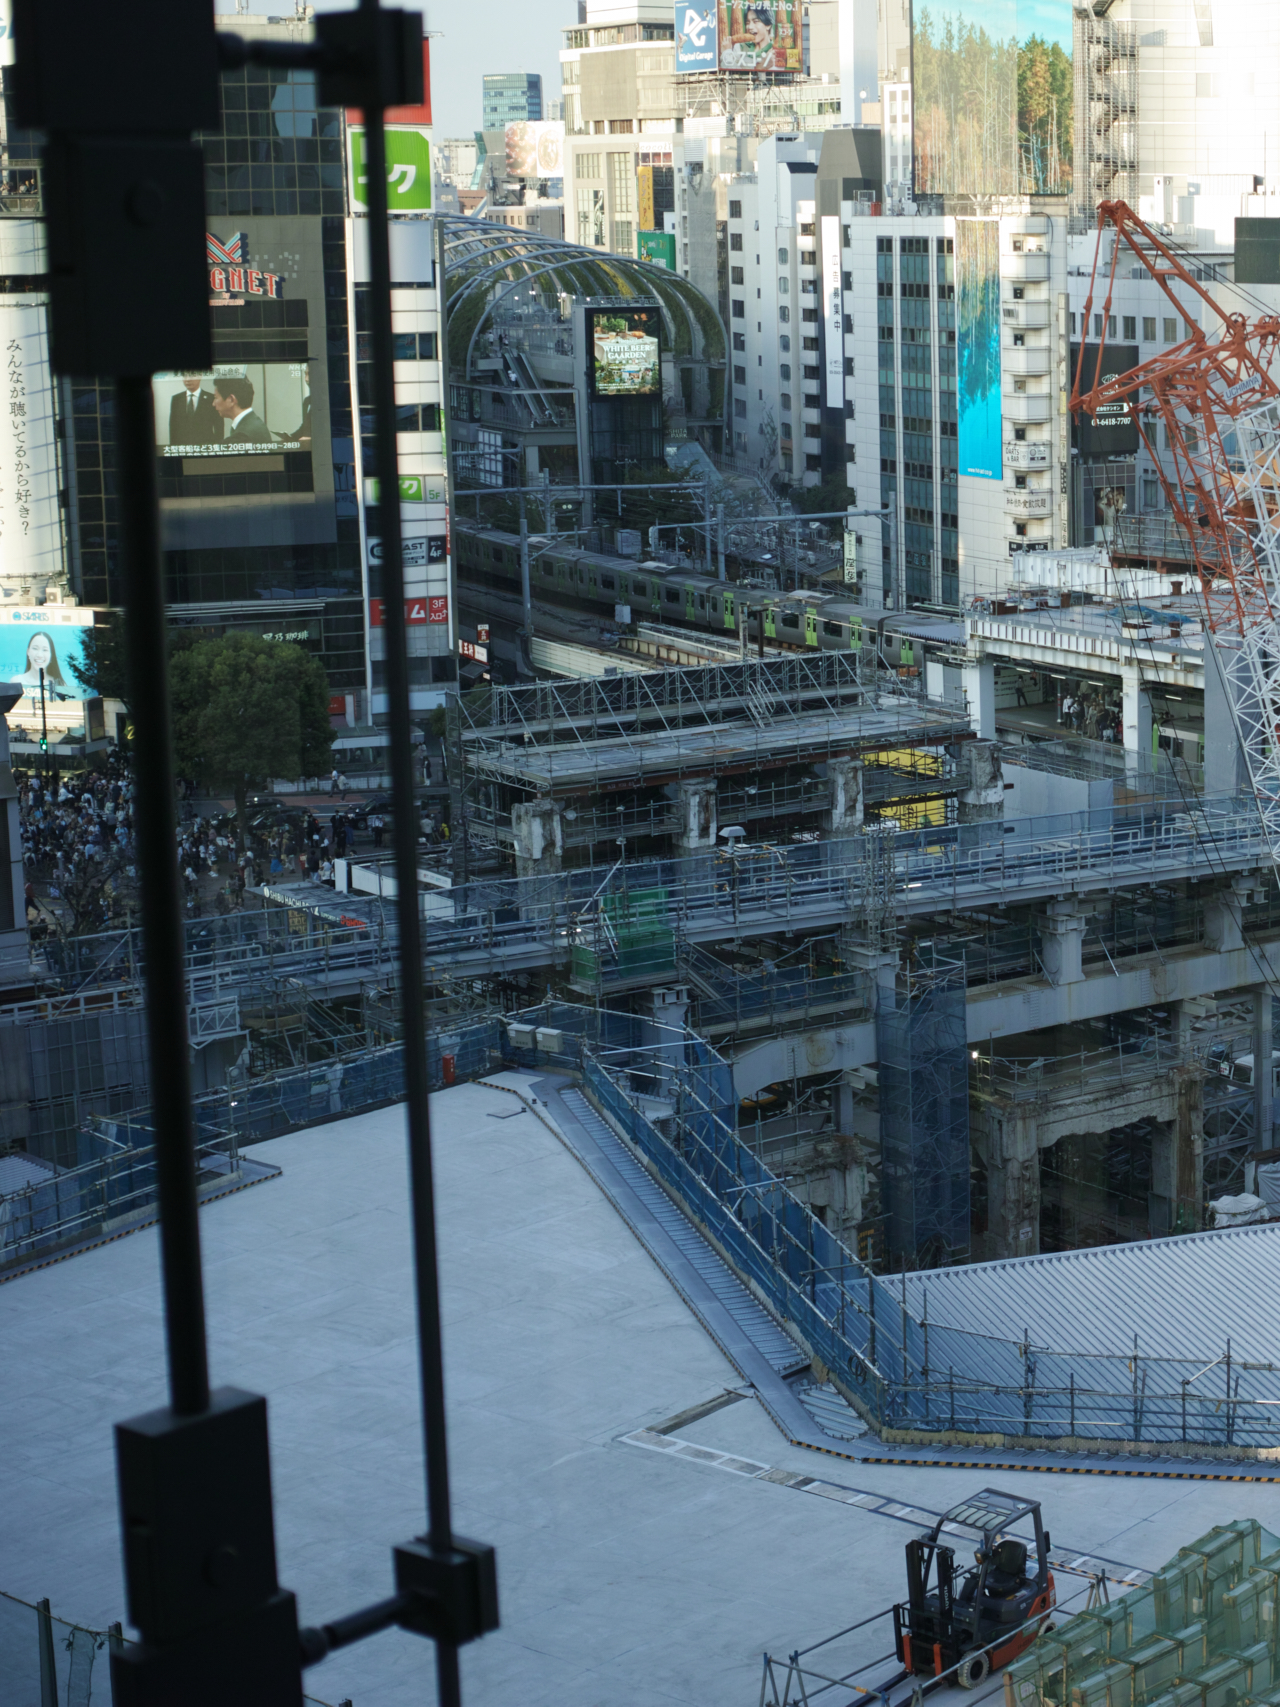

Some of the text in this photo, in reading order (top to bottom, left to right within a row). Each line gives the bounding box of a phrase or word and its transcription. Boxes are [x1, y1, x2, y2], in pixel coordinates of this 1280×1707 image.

[679, 51, 713, 63] Digital Garage
[210, 267, 280, 299] GNET
[631, 344, 651, 352] BEER
[1225, 376, 1260, 399] UCHIMIYA
[428, 489, 441, 500] 5F
[429, 546, 442, 557] 4F
[432, 599, 445, 608] 3F
[270, 890, 285, 904] SHIBU
